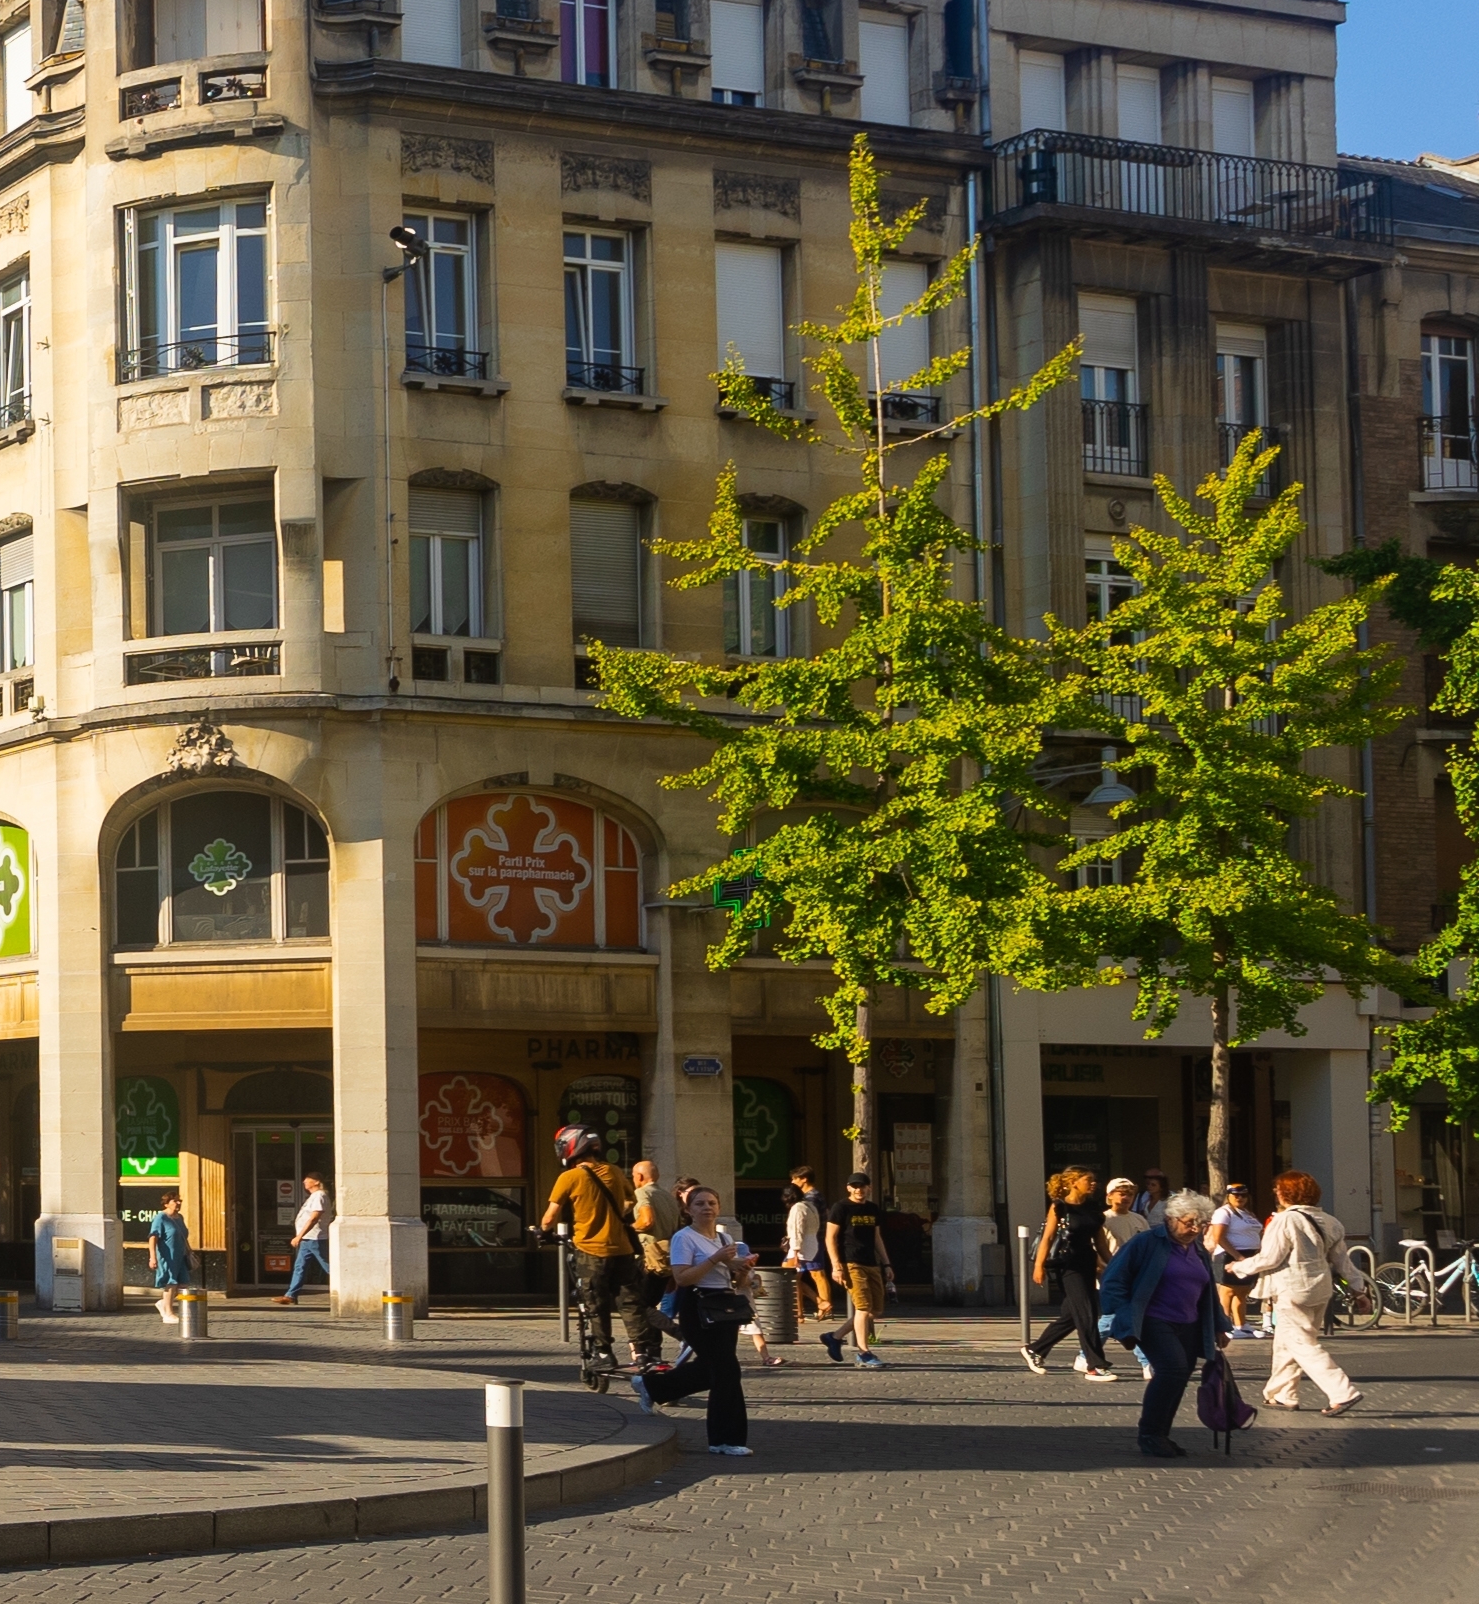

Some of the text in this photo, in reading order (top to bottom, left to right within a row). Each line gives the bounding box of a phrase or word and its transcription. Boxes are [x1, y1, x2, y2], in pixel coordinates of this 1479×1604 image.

[498, 855, 546, 868] Parti Prix
[200, 865, 240, 873] Lafayette
[468, 866, 575, 881] sur la parapharmacie
[569, 1092, 638, 1106] POUR TOUS
[437, 1116, 461, 1127] PRIX
[423, 1203, 498, 1215] PHARMACIE
[427, 1220, 496, 1232] LAFAYETTE
